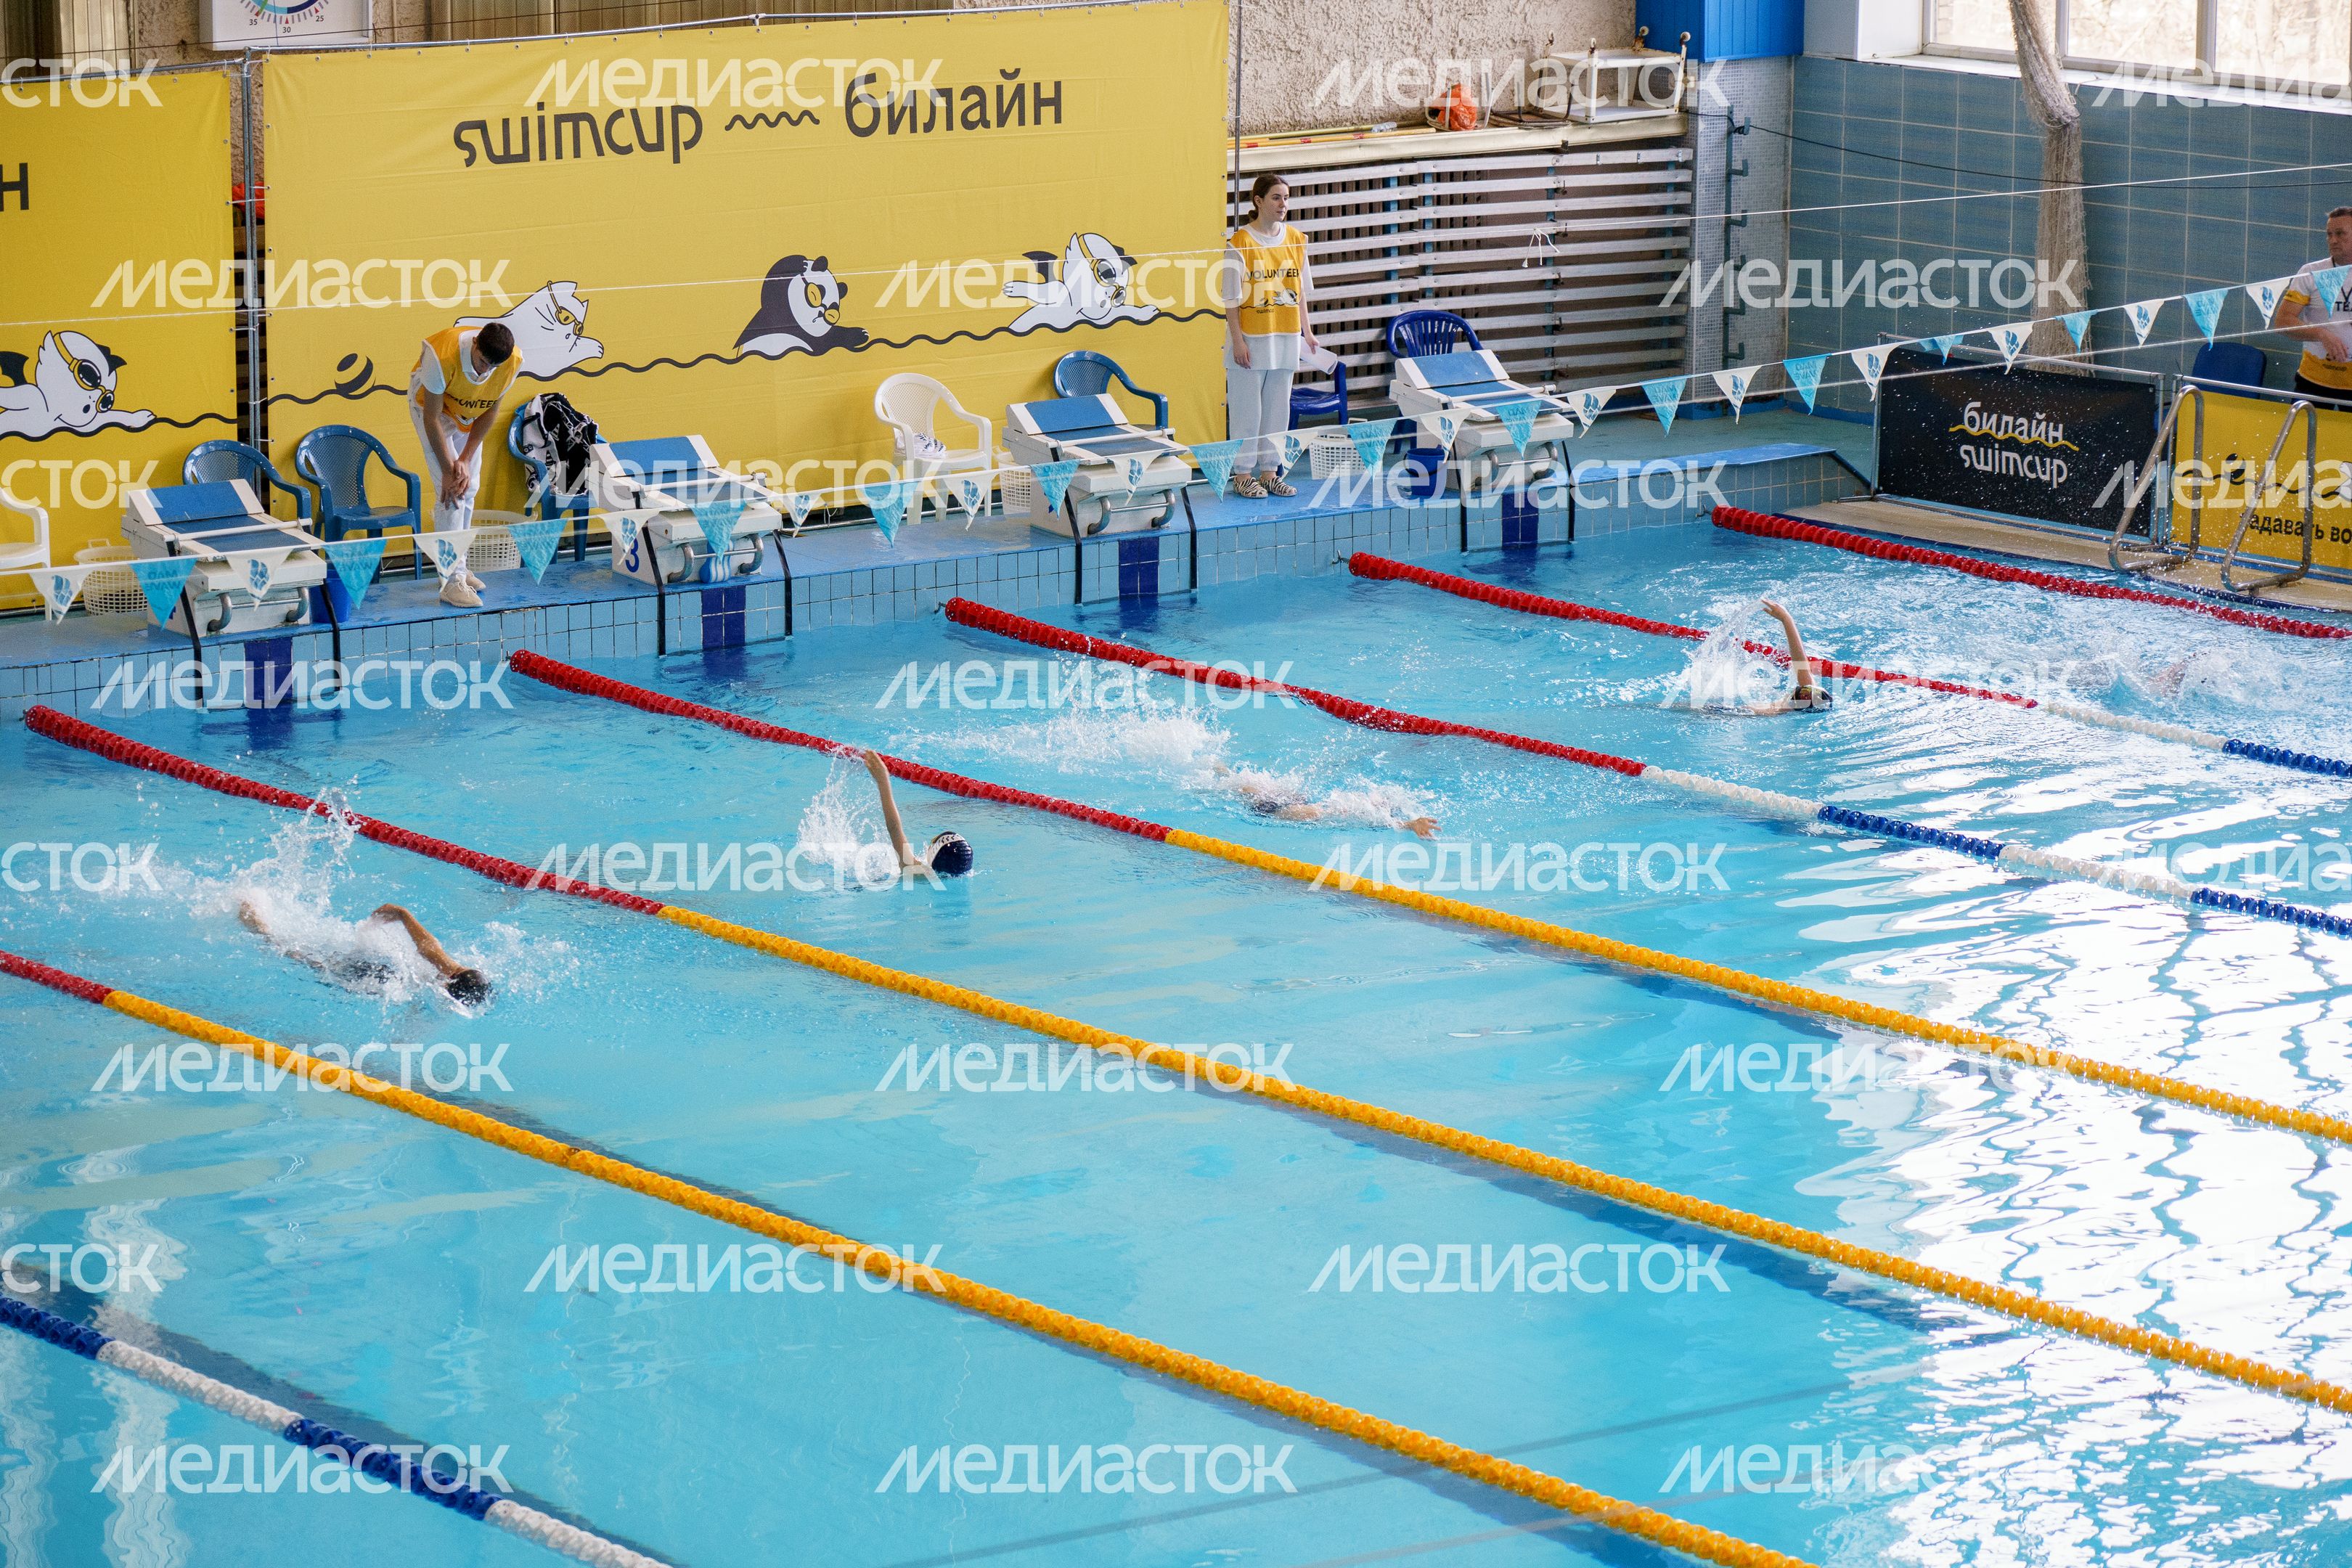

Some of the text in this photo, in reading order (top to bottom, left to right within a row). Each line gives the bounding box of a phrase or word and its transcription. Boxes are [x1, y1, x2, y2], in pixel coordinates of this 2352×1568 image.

[454, 68, 1063, 167] swimcup билайн
[1964, 401, 2064, 444] билайн
[1960, 444, 2068, 489] swimcup
[2241, 513, 2324, 540] адаваь
[625, 538, 640, 573] 3
